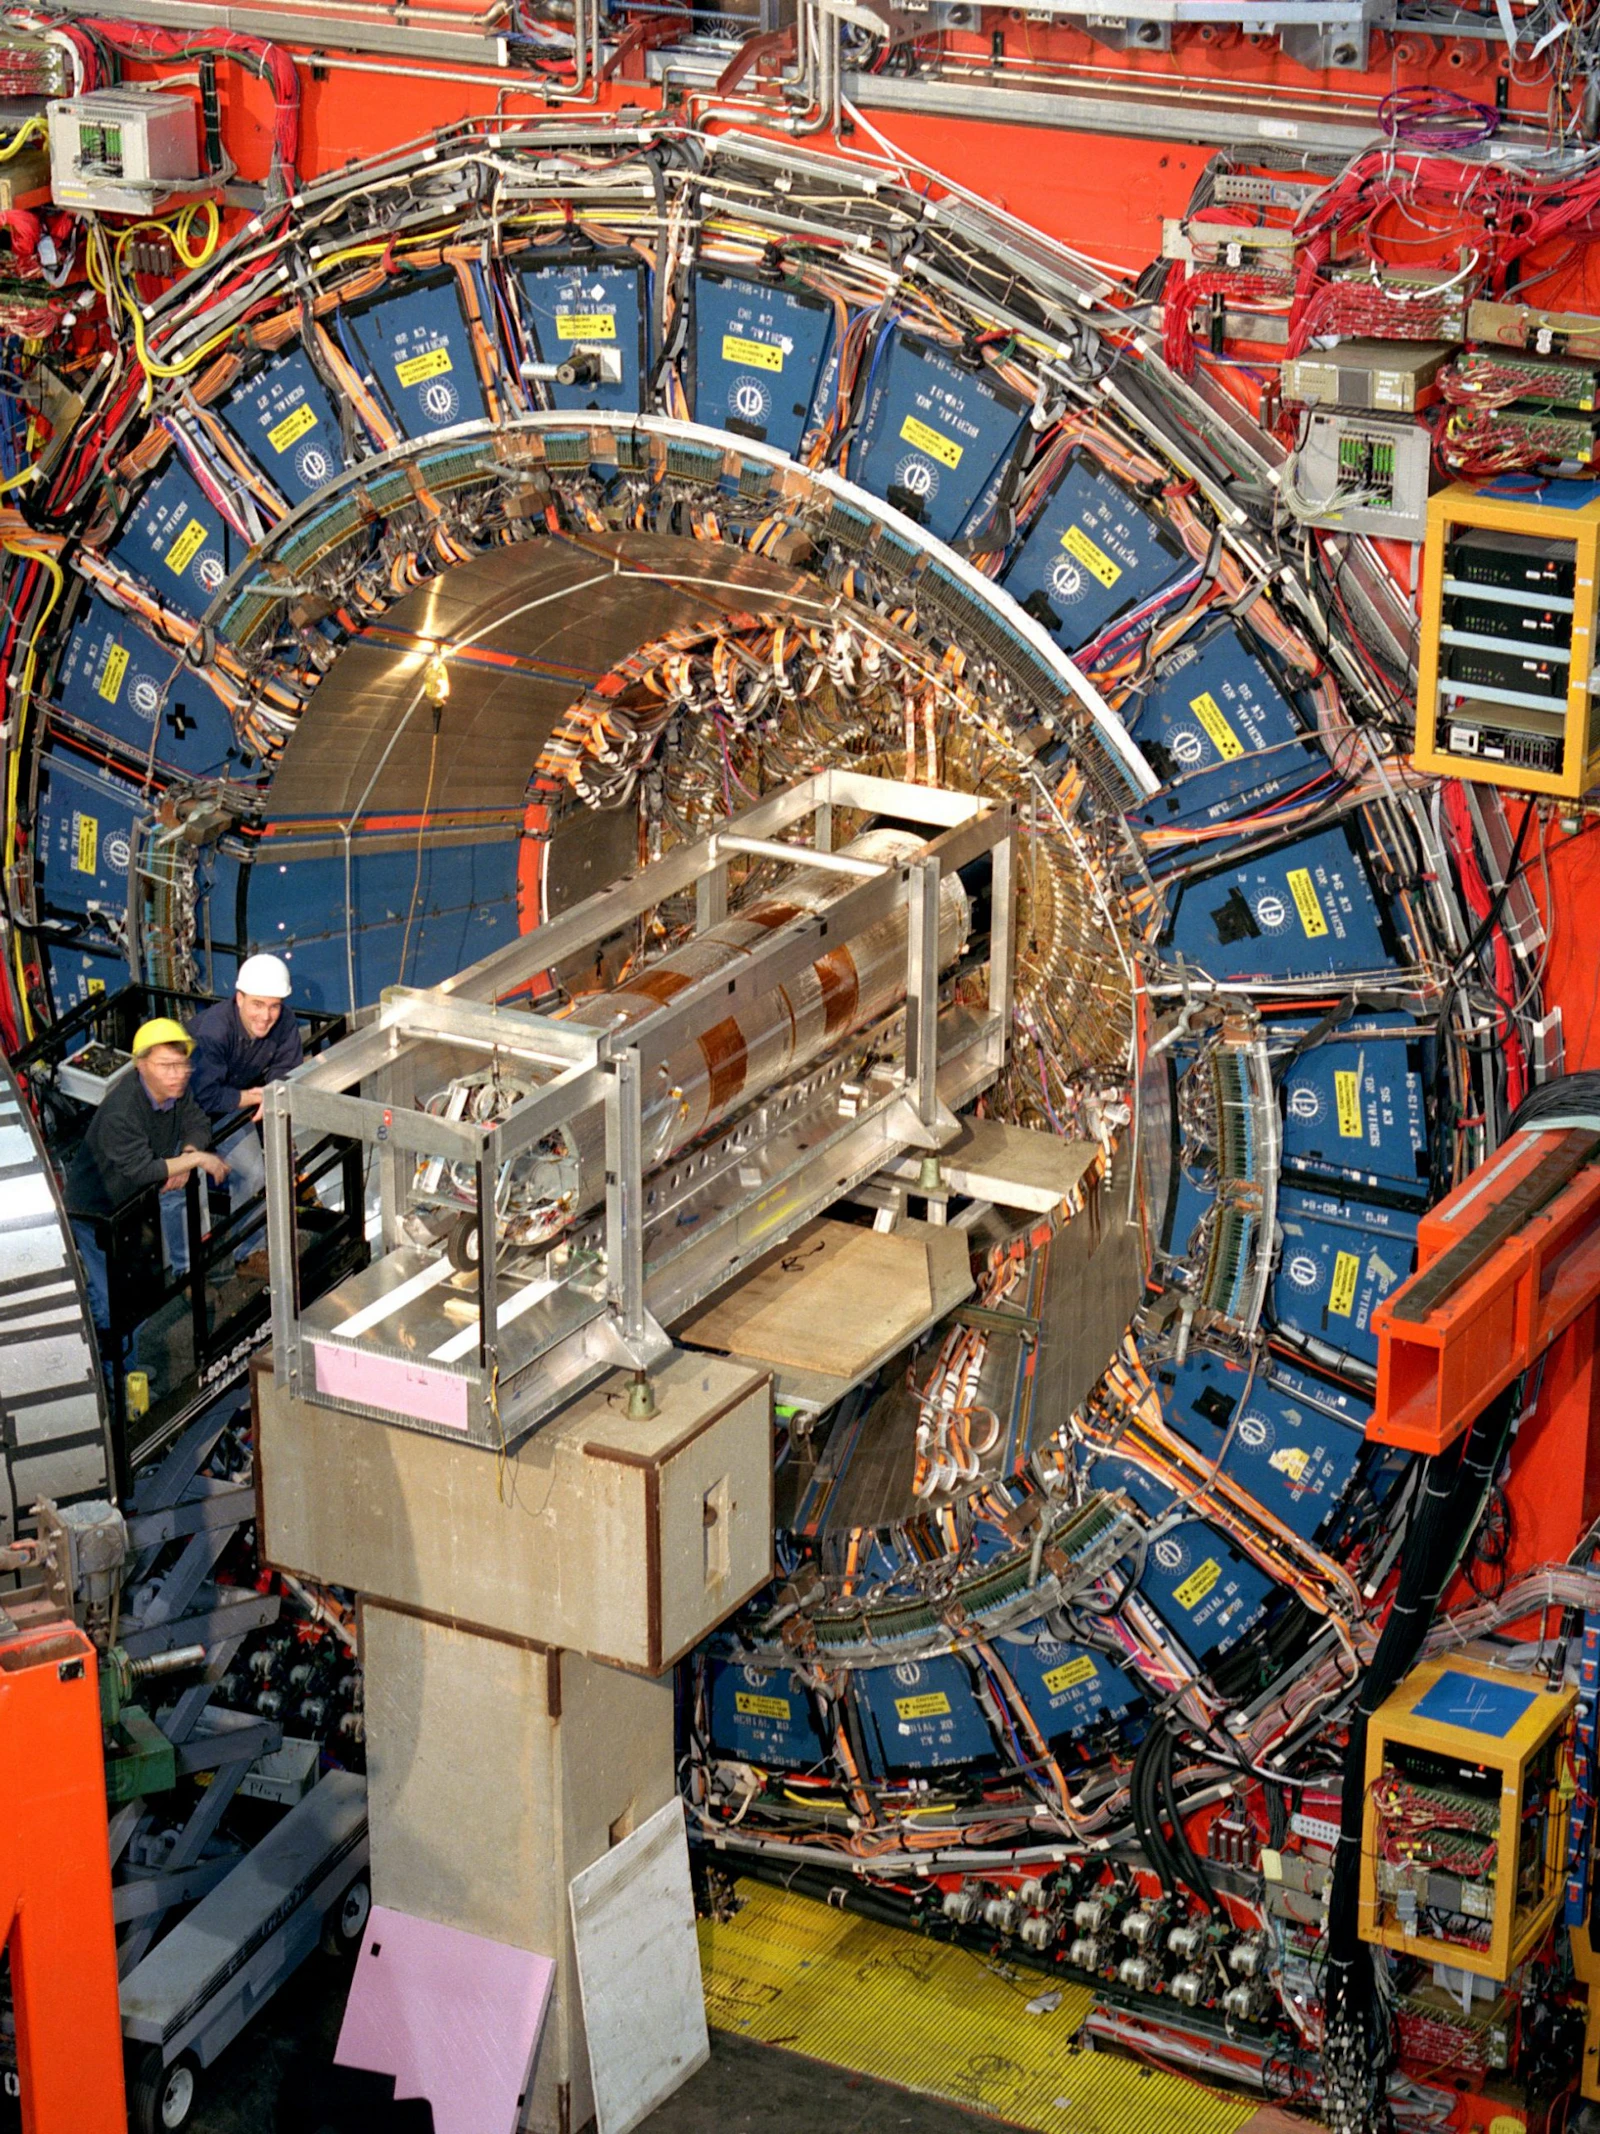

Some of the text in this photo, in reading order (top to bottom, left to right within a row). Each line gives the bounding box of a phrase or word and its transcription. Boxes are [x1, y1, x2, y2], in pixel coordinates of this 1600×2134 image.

[939, 406, 979, 437] SERIAL
[1237, 704, 1266, 750] SERIAL
[1331, 873, 1343, 890] 34
[1324, 891, 1346, 938] SERIAL
[1367, 1101, 1380, 1146] SERIAL
[1355, 1288, 1371, 1329] SERIAL
[1290, 1465, 1315, 1501] SERIAL
